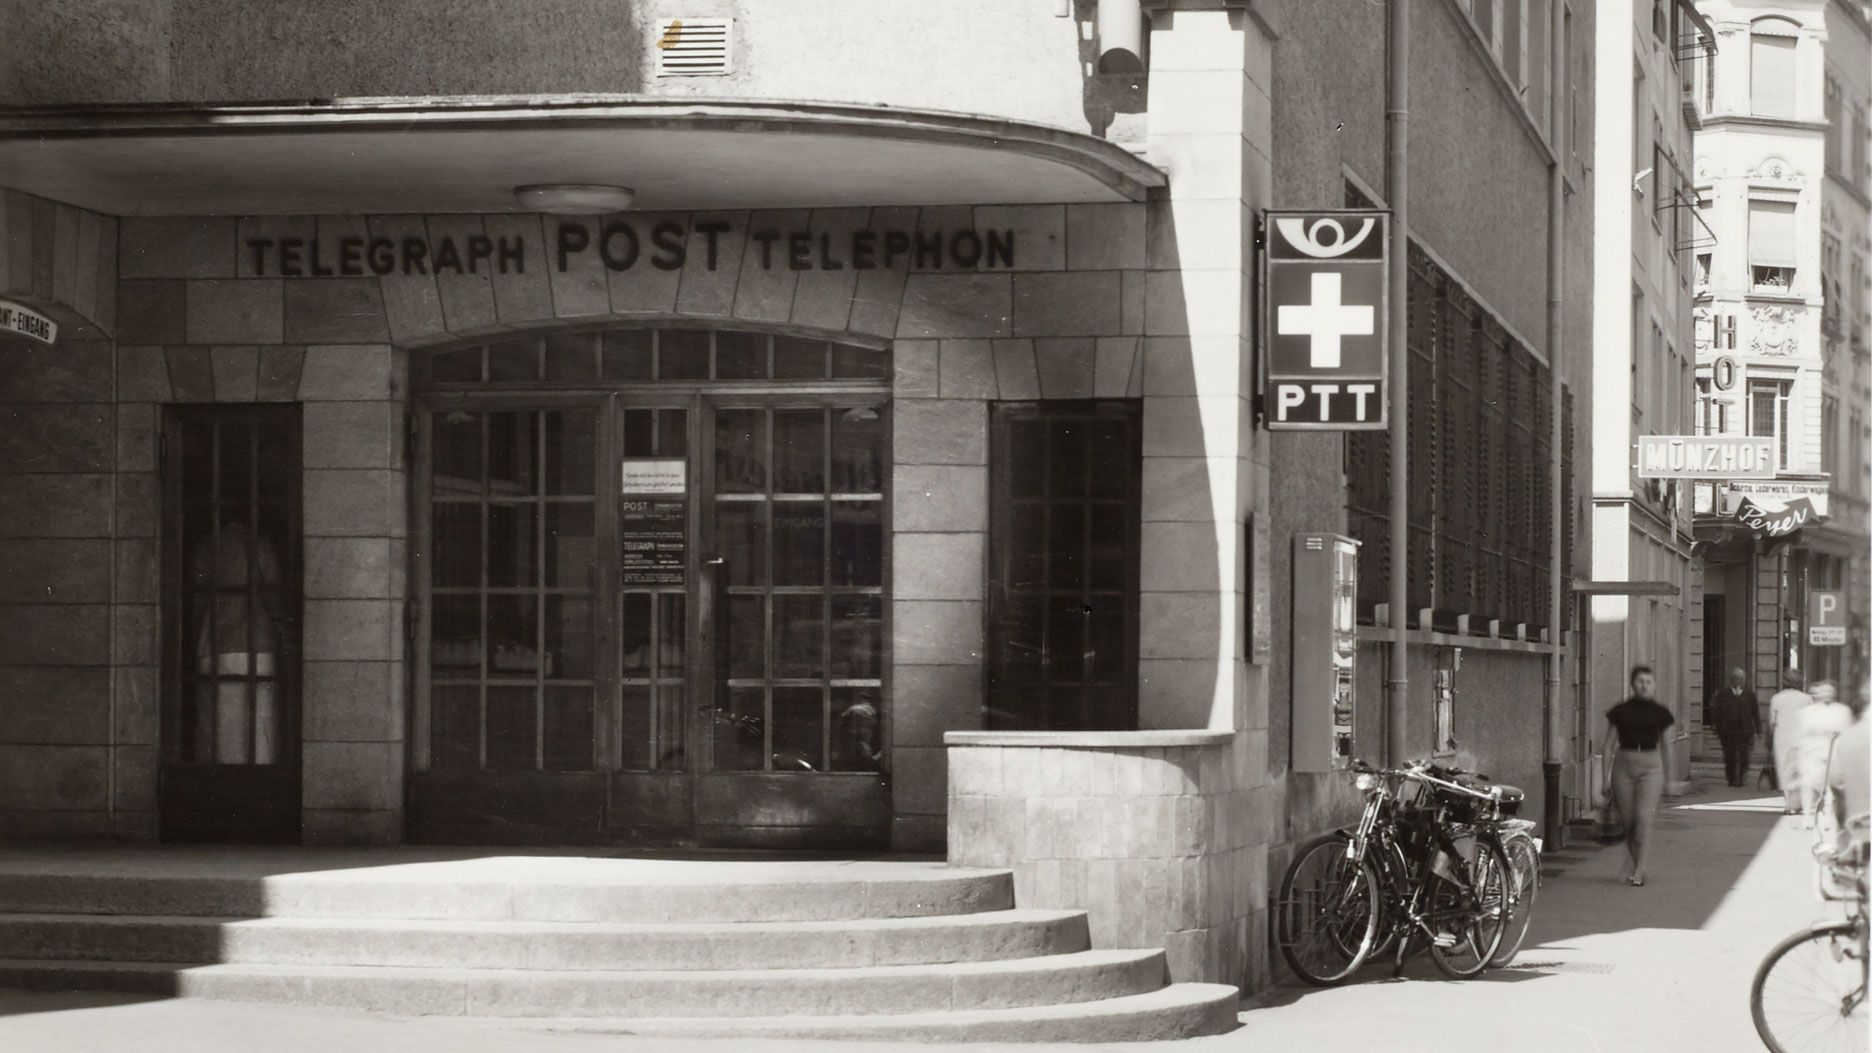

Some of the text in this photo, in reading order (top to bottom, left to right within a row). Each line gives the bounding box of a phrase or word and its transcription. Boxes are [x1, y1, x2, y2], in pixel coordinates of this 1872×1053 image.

[247, 222, 1014, 276] TELEGRAPH POST TELEPHON
[1278, 384, 1375, 421] PTT
[1646, 440, 1771, 472] MÜNZHOF
[623, 502, 648, 511] POST
[1820, 594, 1836, 625] P
